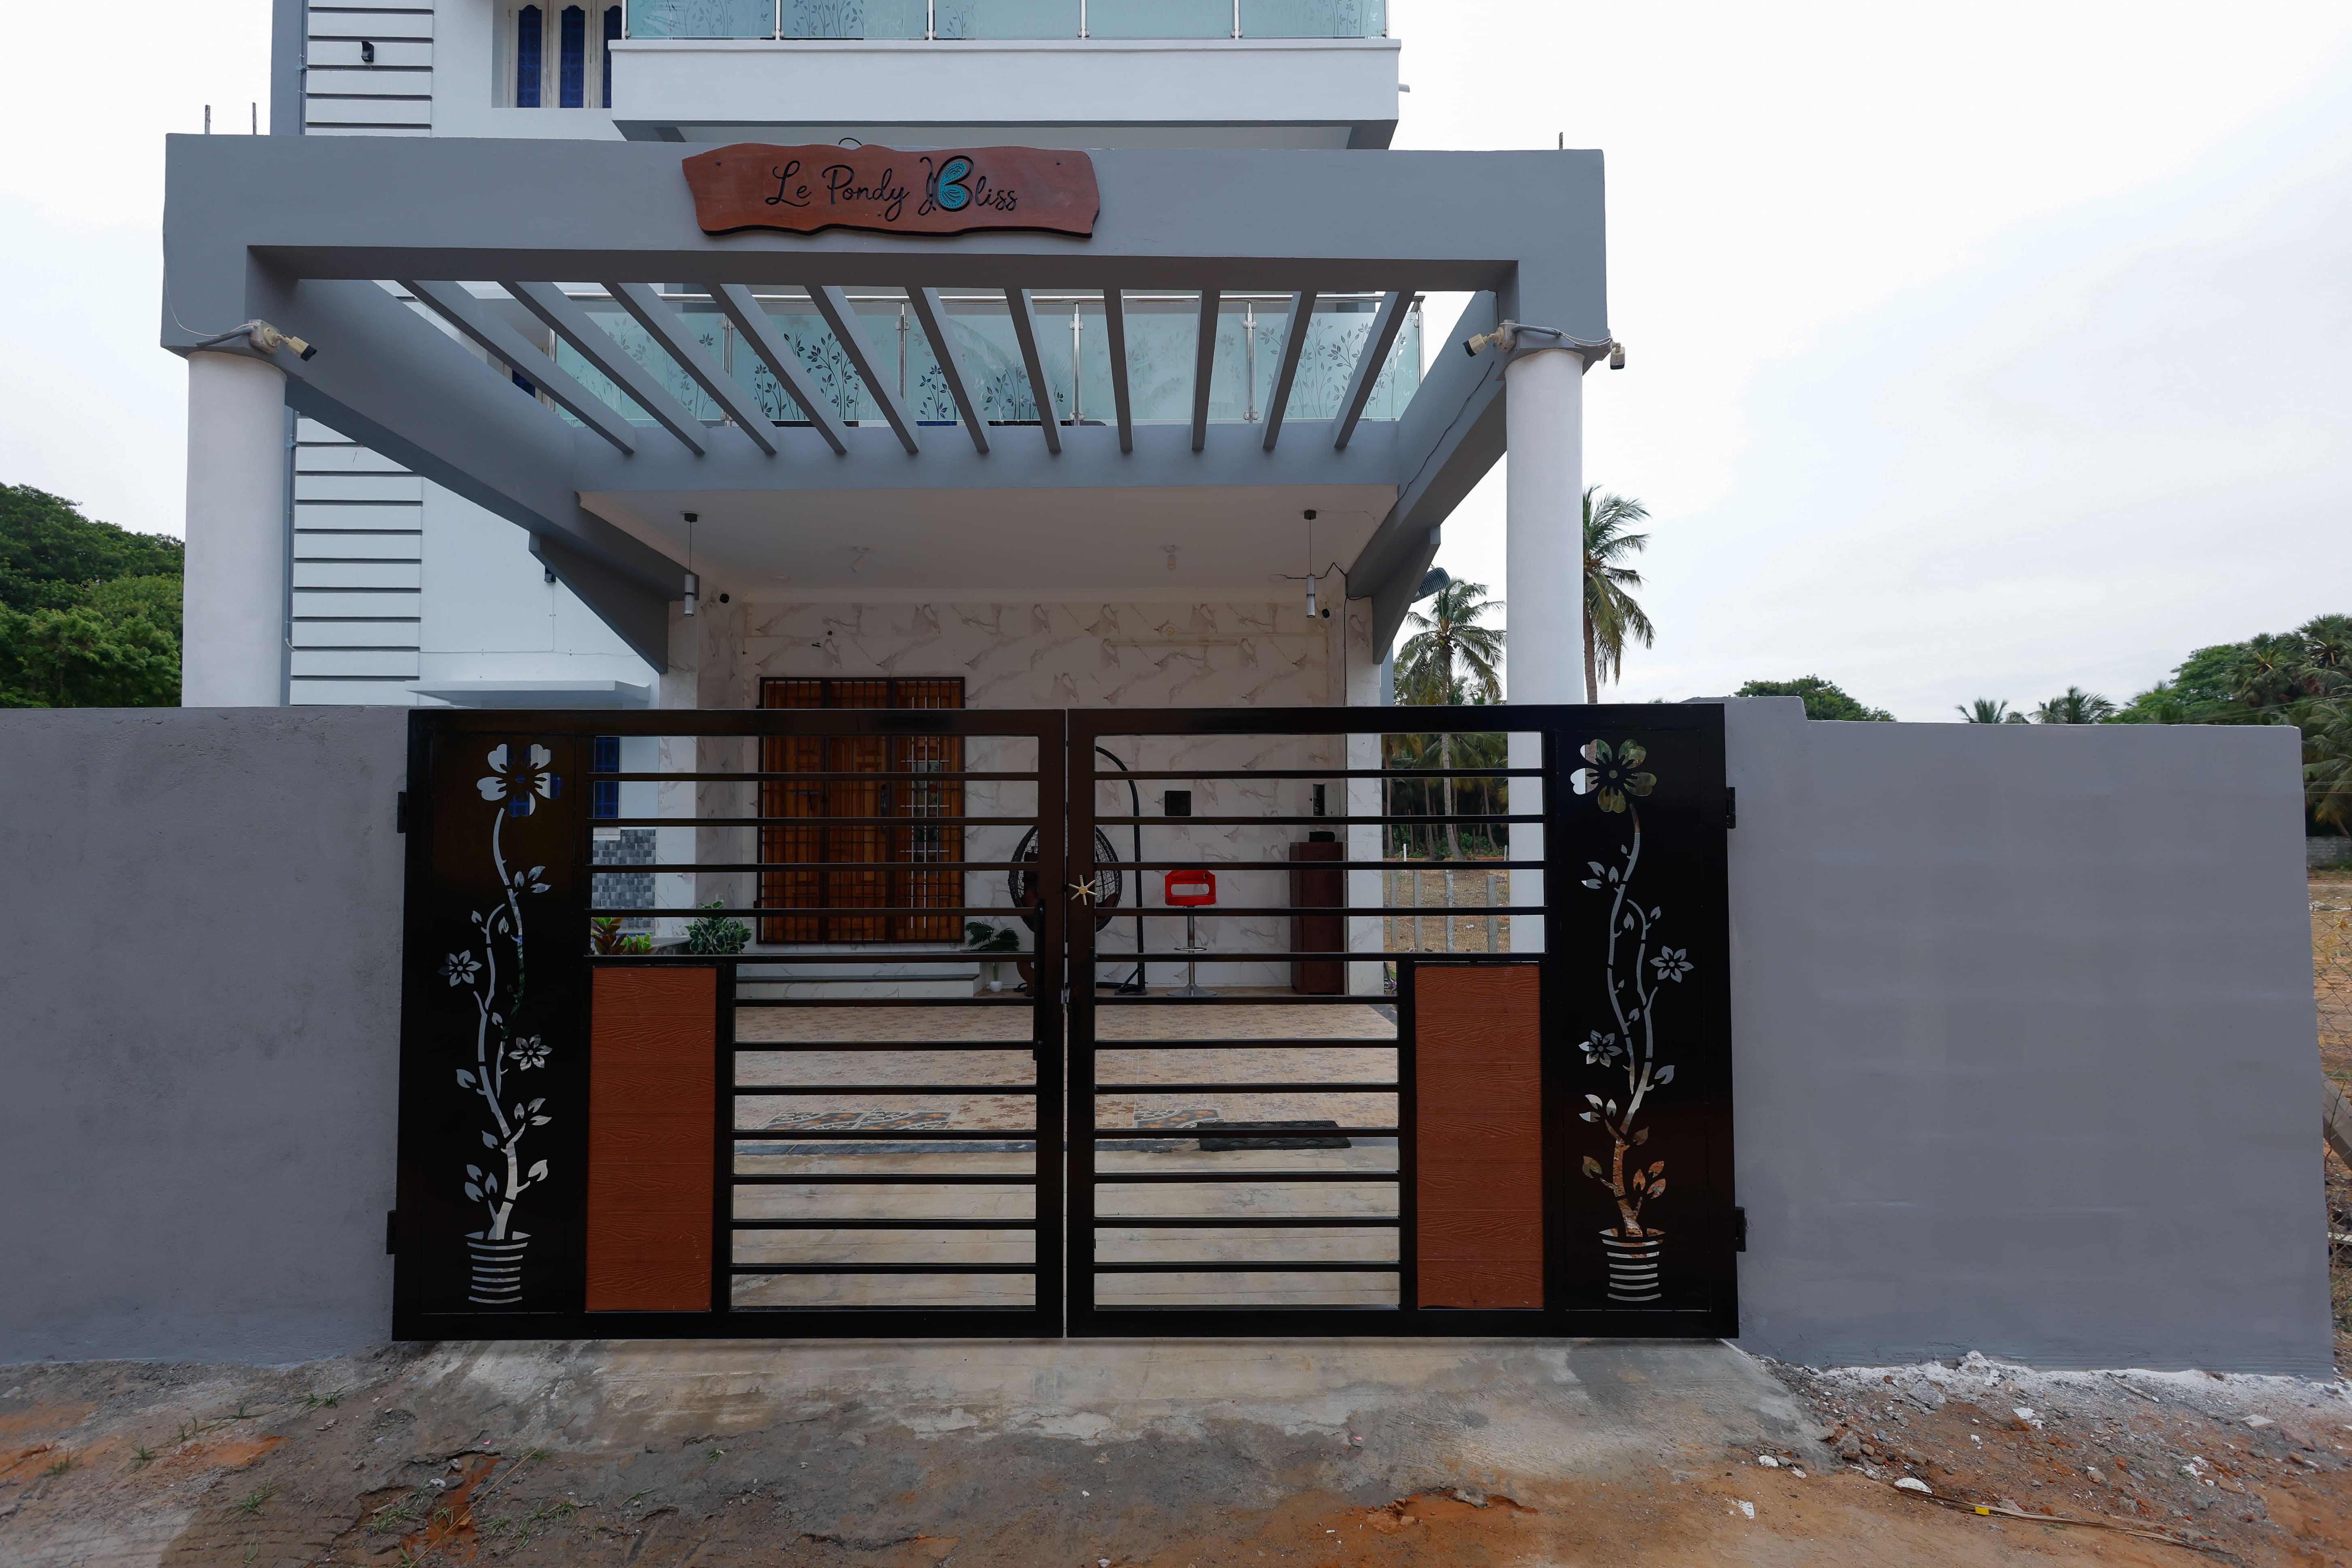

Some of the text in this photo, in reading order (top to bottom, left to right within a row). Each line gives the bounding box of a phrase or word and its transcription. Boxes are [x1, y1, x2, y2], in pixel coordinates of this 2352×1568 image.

[765, 155, 1018, 222] Le Pondy Bliss
